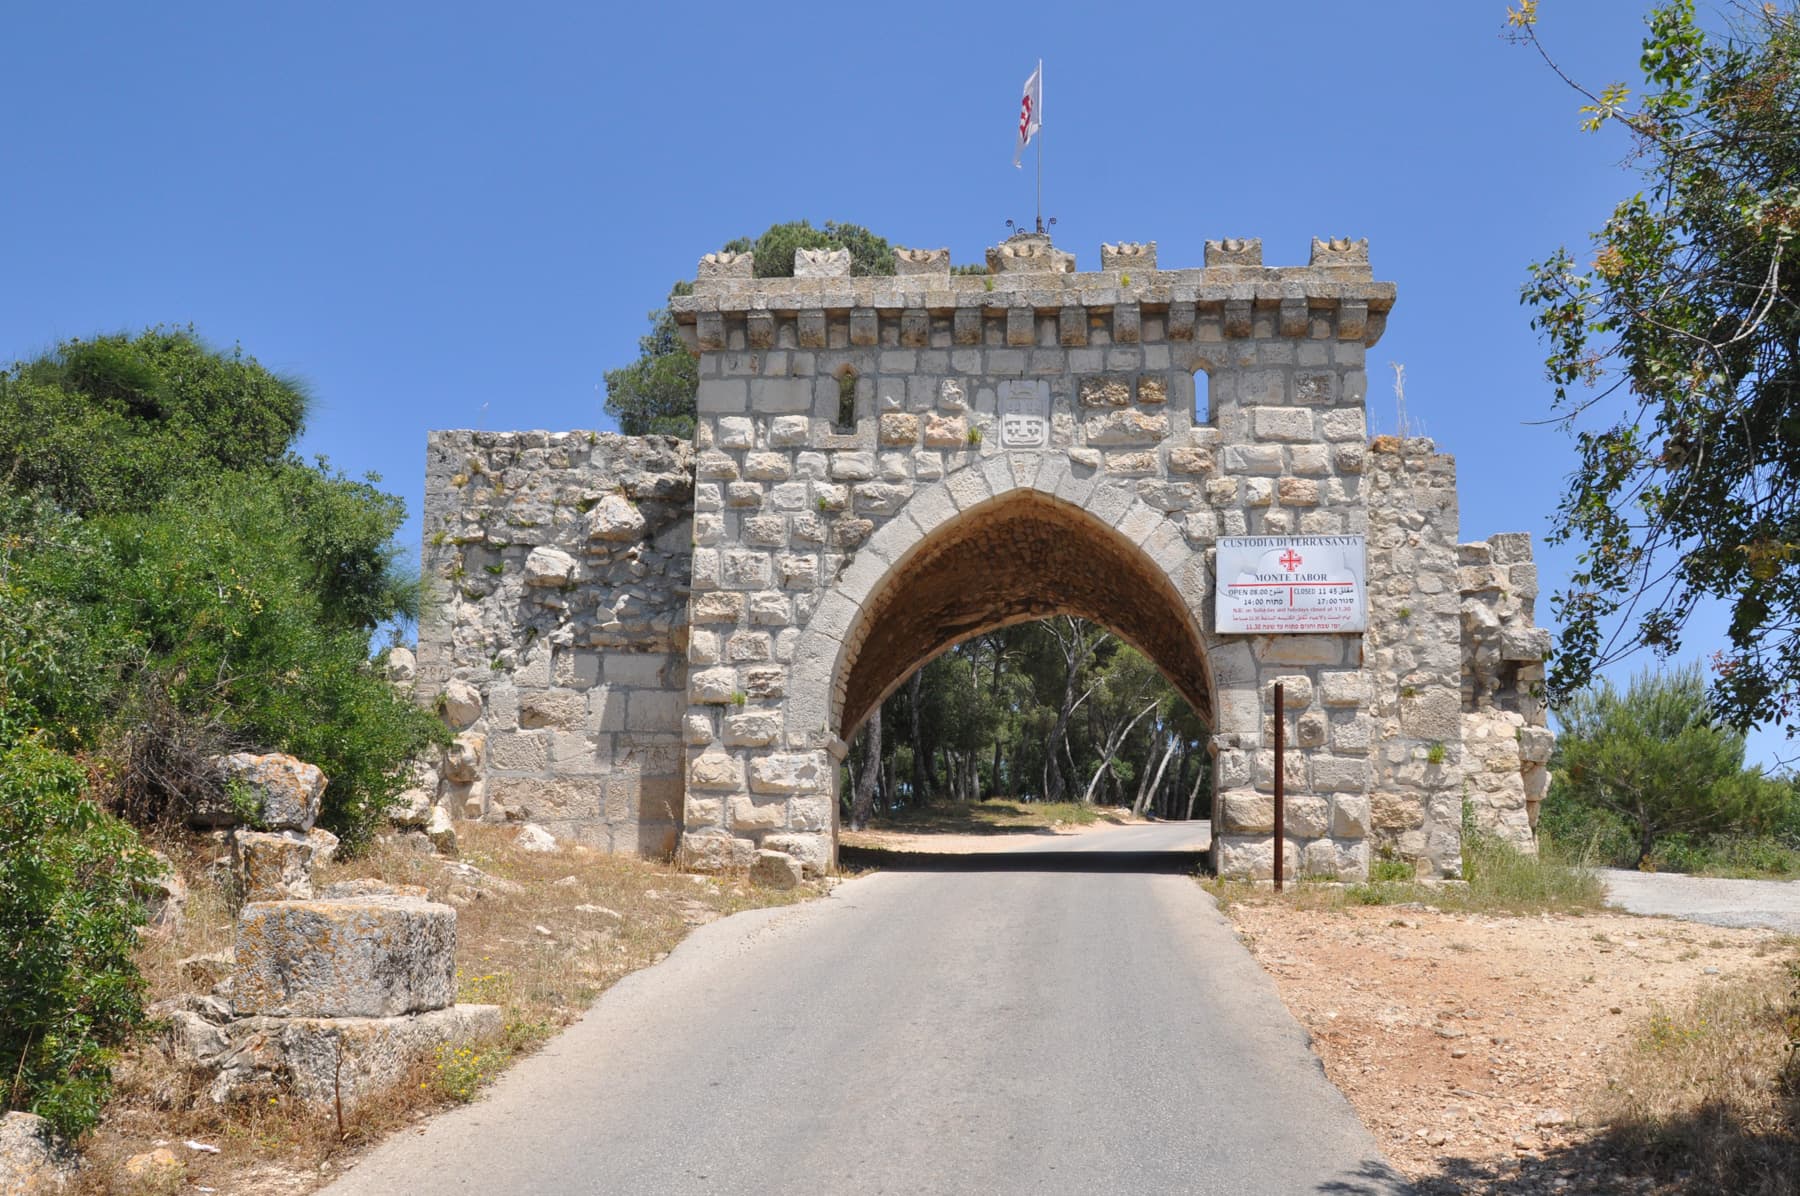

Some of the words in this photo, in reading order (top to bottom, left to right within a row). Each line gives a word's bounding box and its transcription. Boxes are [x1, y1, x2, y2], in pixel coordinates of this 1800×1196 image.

[1223, 539, 1274, 548] CUSTODIA
[1277, 539, 1287, 547] DI
[1290, 538, 1323, 547] TERRA
[1323, 537, 1358, 546] SANTA
[1255, 573, 1292, 582] MONTE
[1295, 573, 1328, 581] TABOR
[1294, 587, 1316, 595] CLOSED
